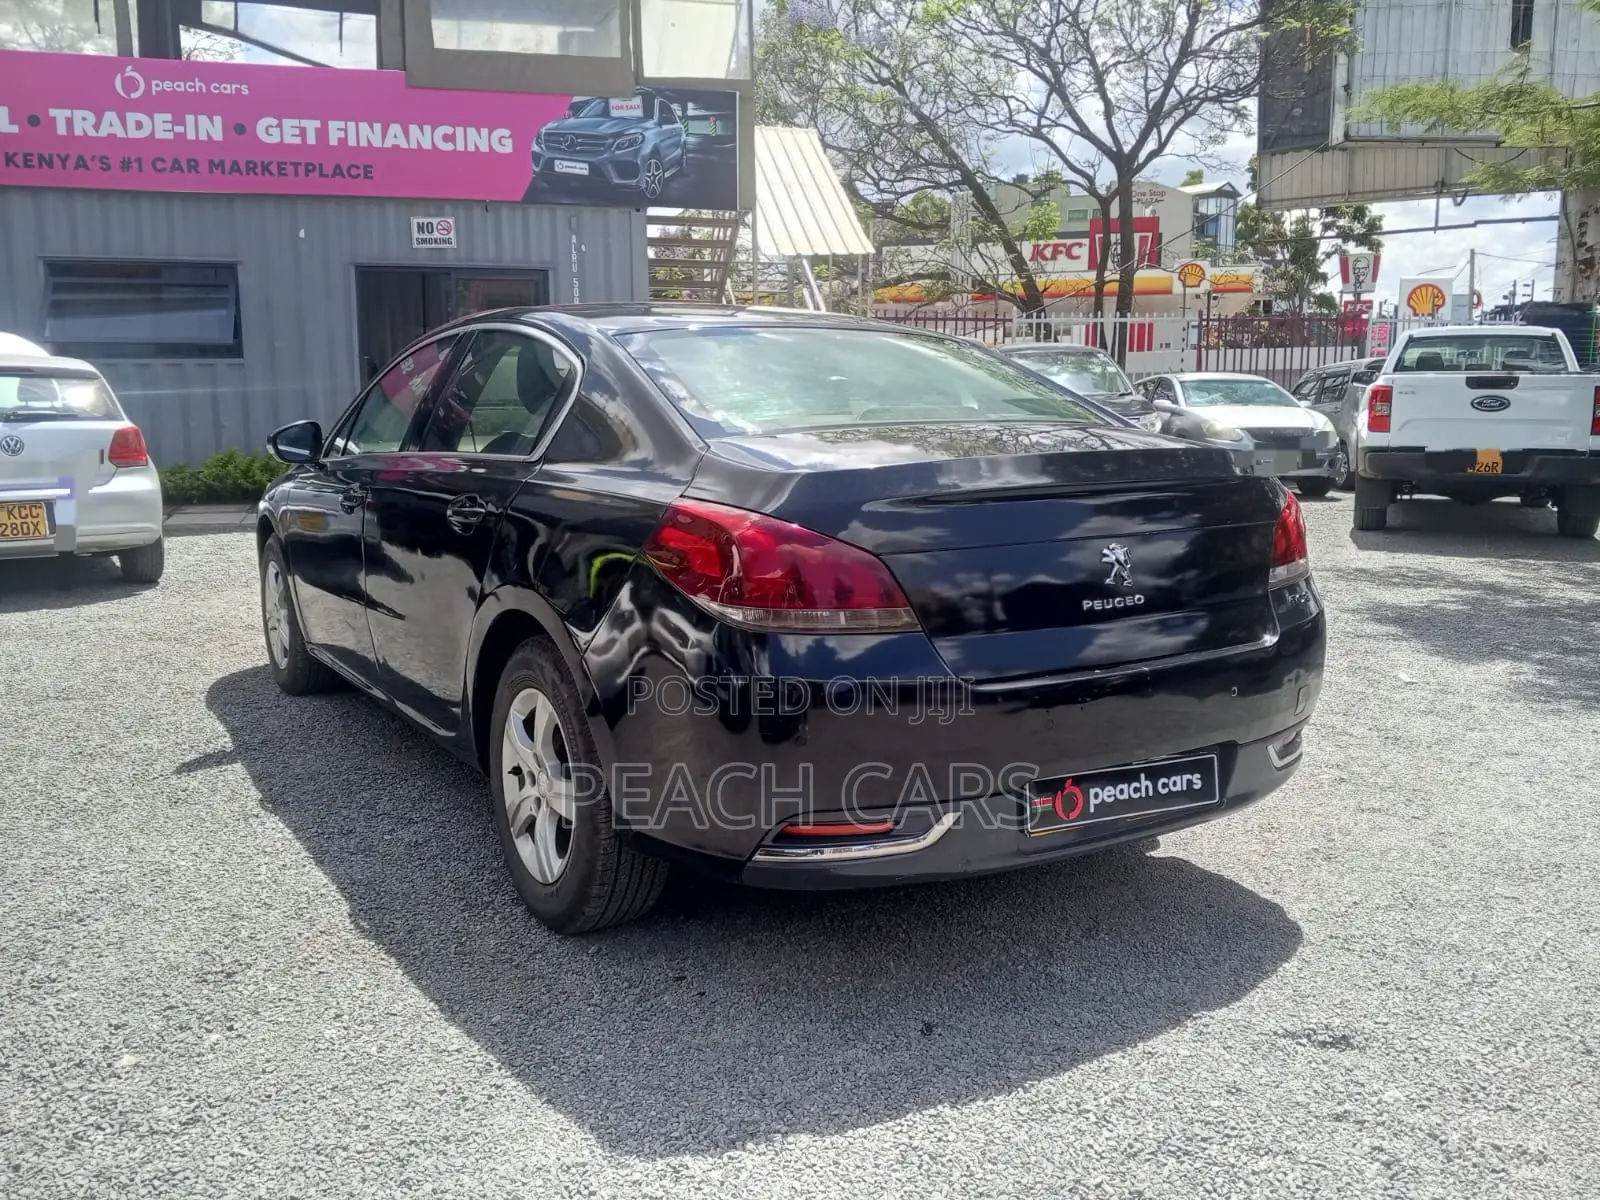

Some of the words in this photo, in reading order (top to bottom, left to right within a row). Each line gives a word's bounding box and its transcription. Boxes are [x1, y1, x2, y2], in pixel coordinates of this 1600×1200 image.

[151, 72, 206, 96] peach
[210, 80, 249, 95] cars
[48, 107, 224, 142] TRADE-IN
[256, 117, 322, 145] GET
[328, 120, 514, 154] FINANCING
[4, 151, 112, 172] KENYA'S
[119, 156, 144, 174] #1
[151, 156, 201, 175] CAR
[208, 158, 375, 181] MARKETPLACE
[416, 221, 435, 235] NO
[415, 237, 453, 246] SMOKING
[1029, 241, 1084, 262] KFC
[1345, 303, 1372, 312] KFC
[6, 504, 40, 520] KCC
[0, 520, 42, 537] 280X
[1089, 772, 1154, 813] peach
[1157, 772, 1203, 795] cars
